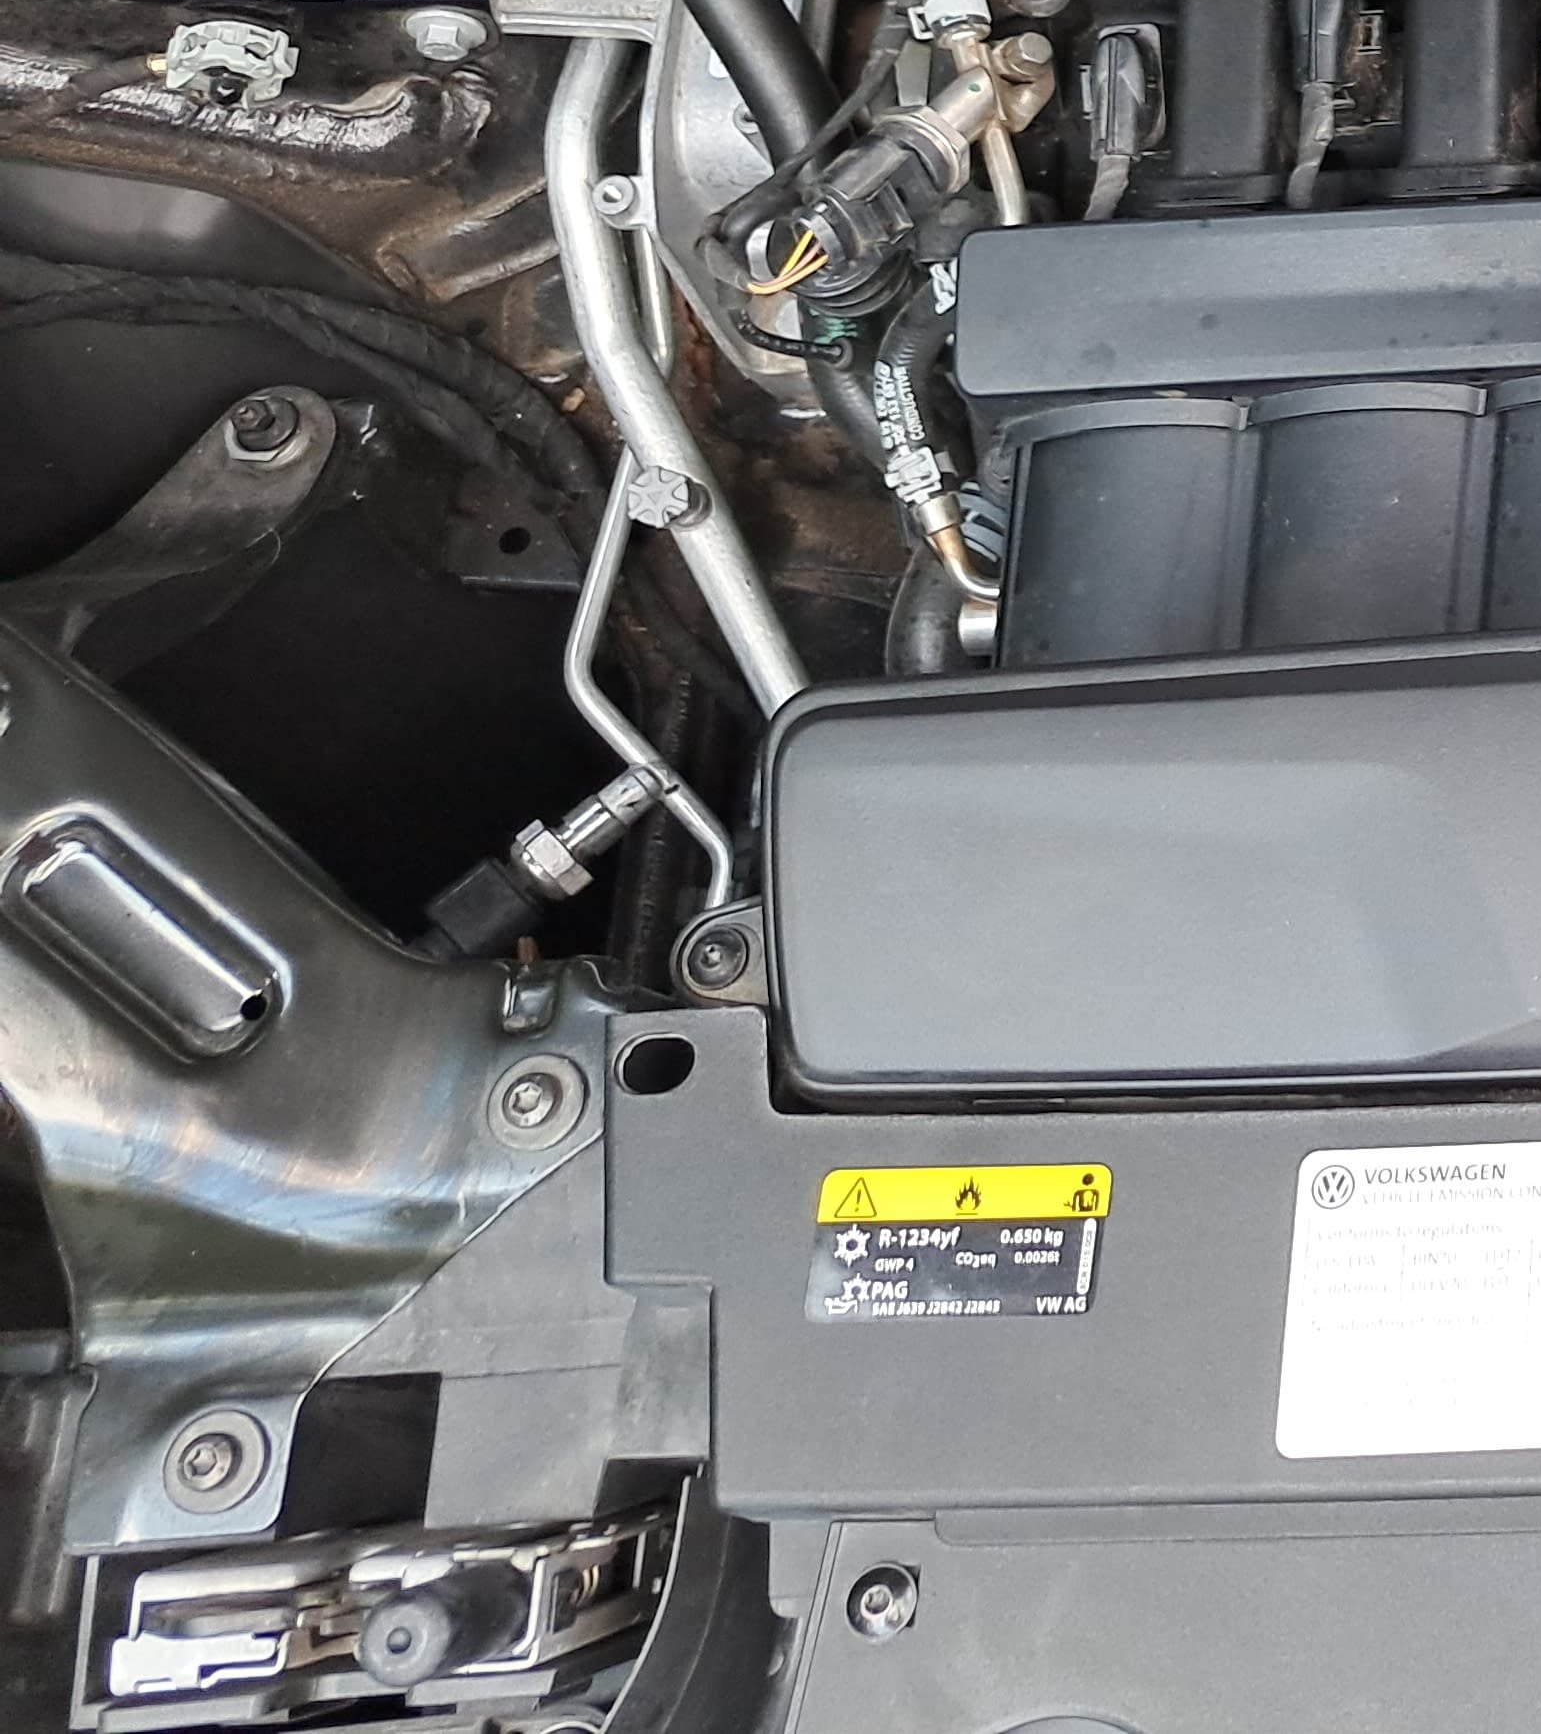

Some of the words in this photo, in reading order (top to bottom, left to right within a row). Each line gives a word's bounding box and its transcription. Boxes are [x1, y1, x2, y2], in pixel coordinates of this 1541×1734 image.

[893, 366, 926, 441] CONDUCTIVE
[1364, 1163, 1507, 1185] VOLKSWAGEN
[878, 1226, 961, 1250] R-1234yf
[1000, 1228, 1042, 1245] 0.650
[1043, 1228, 1064, 1247] kg
[874, 1259, 904, 1273] GWP
[905, 1258, 914, 1272] 4
[871, 1281, 909, 1299] PAG
[1036, 1297, 1062, 1314] VW
[1064, 1296, 1087, 1313] AG
